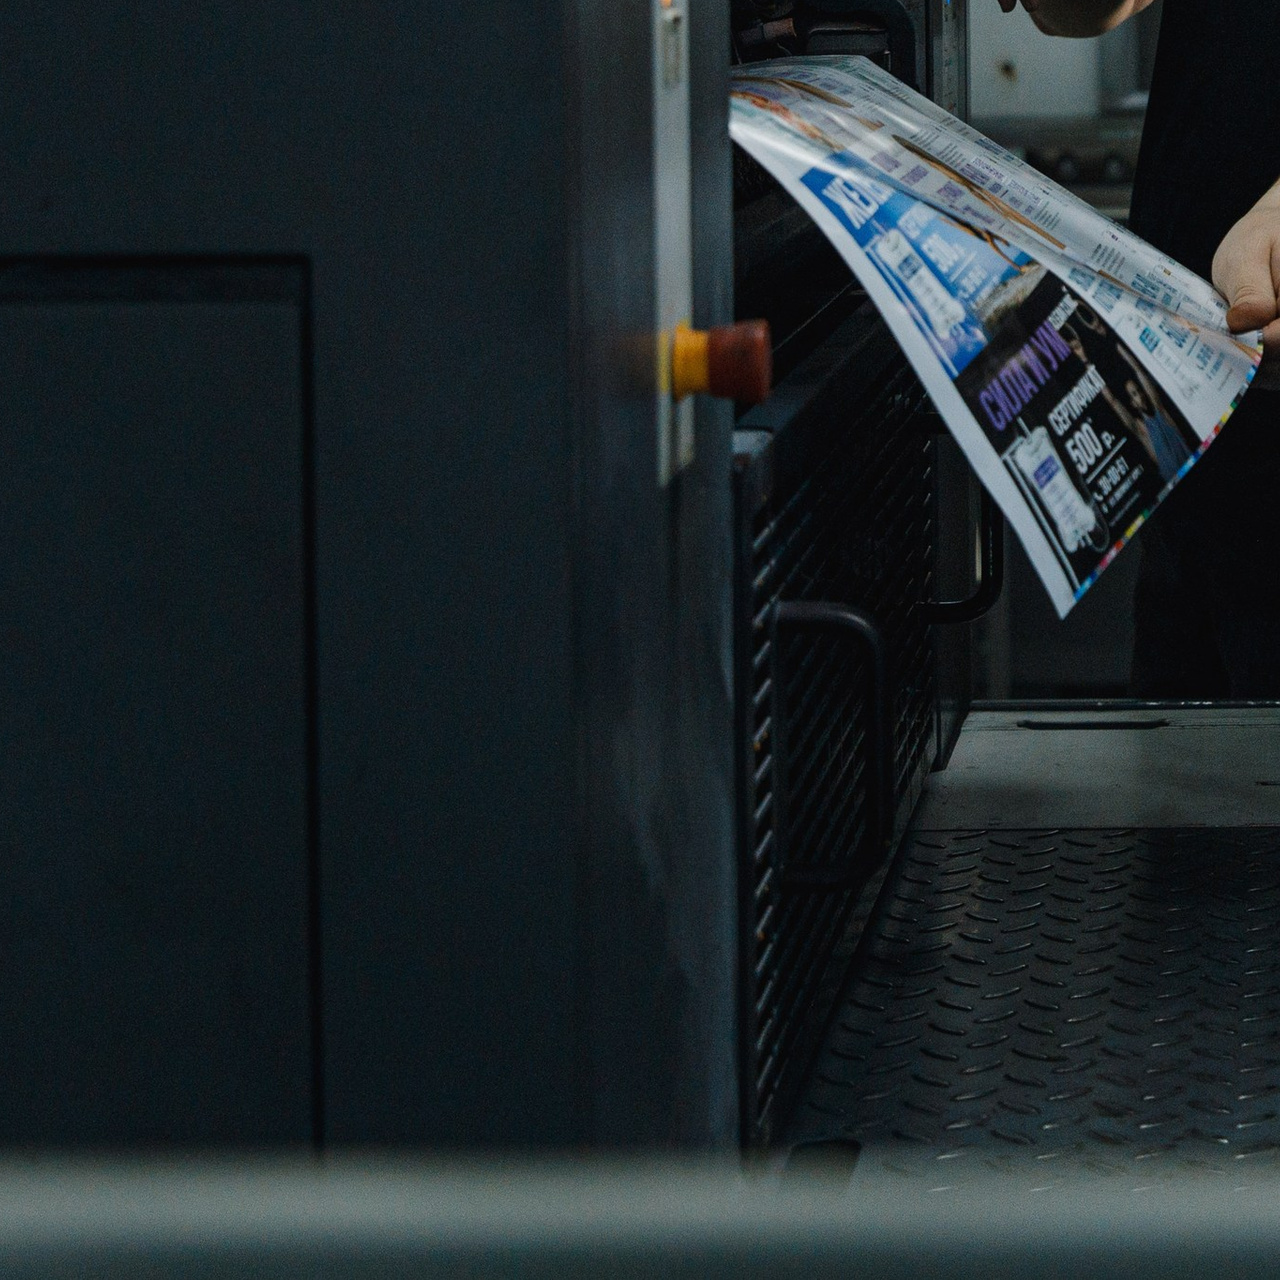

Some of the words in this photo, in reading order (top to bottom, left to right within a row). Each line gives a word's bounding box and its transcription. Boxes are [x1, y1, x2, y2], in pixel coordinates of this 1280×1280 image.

[1020, 342, 1051, 386] И
[1029, 319, 1072, 371] УМ
[979, 357, 1040, 432] СИЛА
[1048, 363, 1107, 437] СЕРТИФИКАТ
